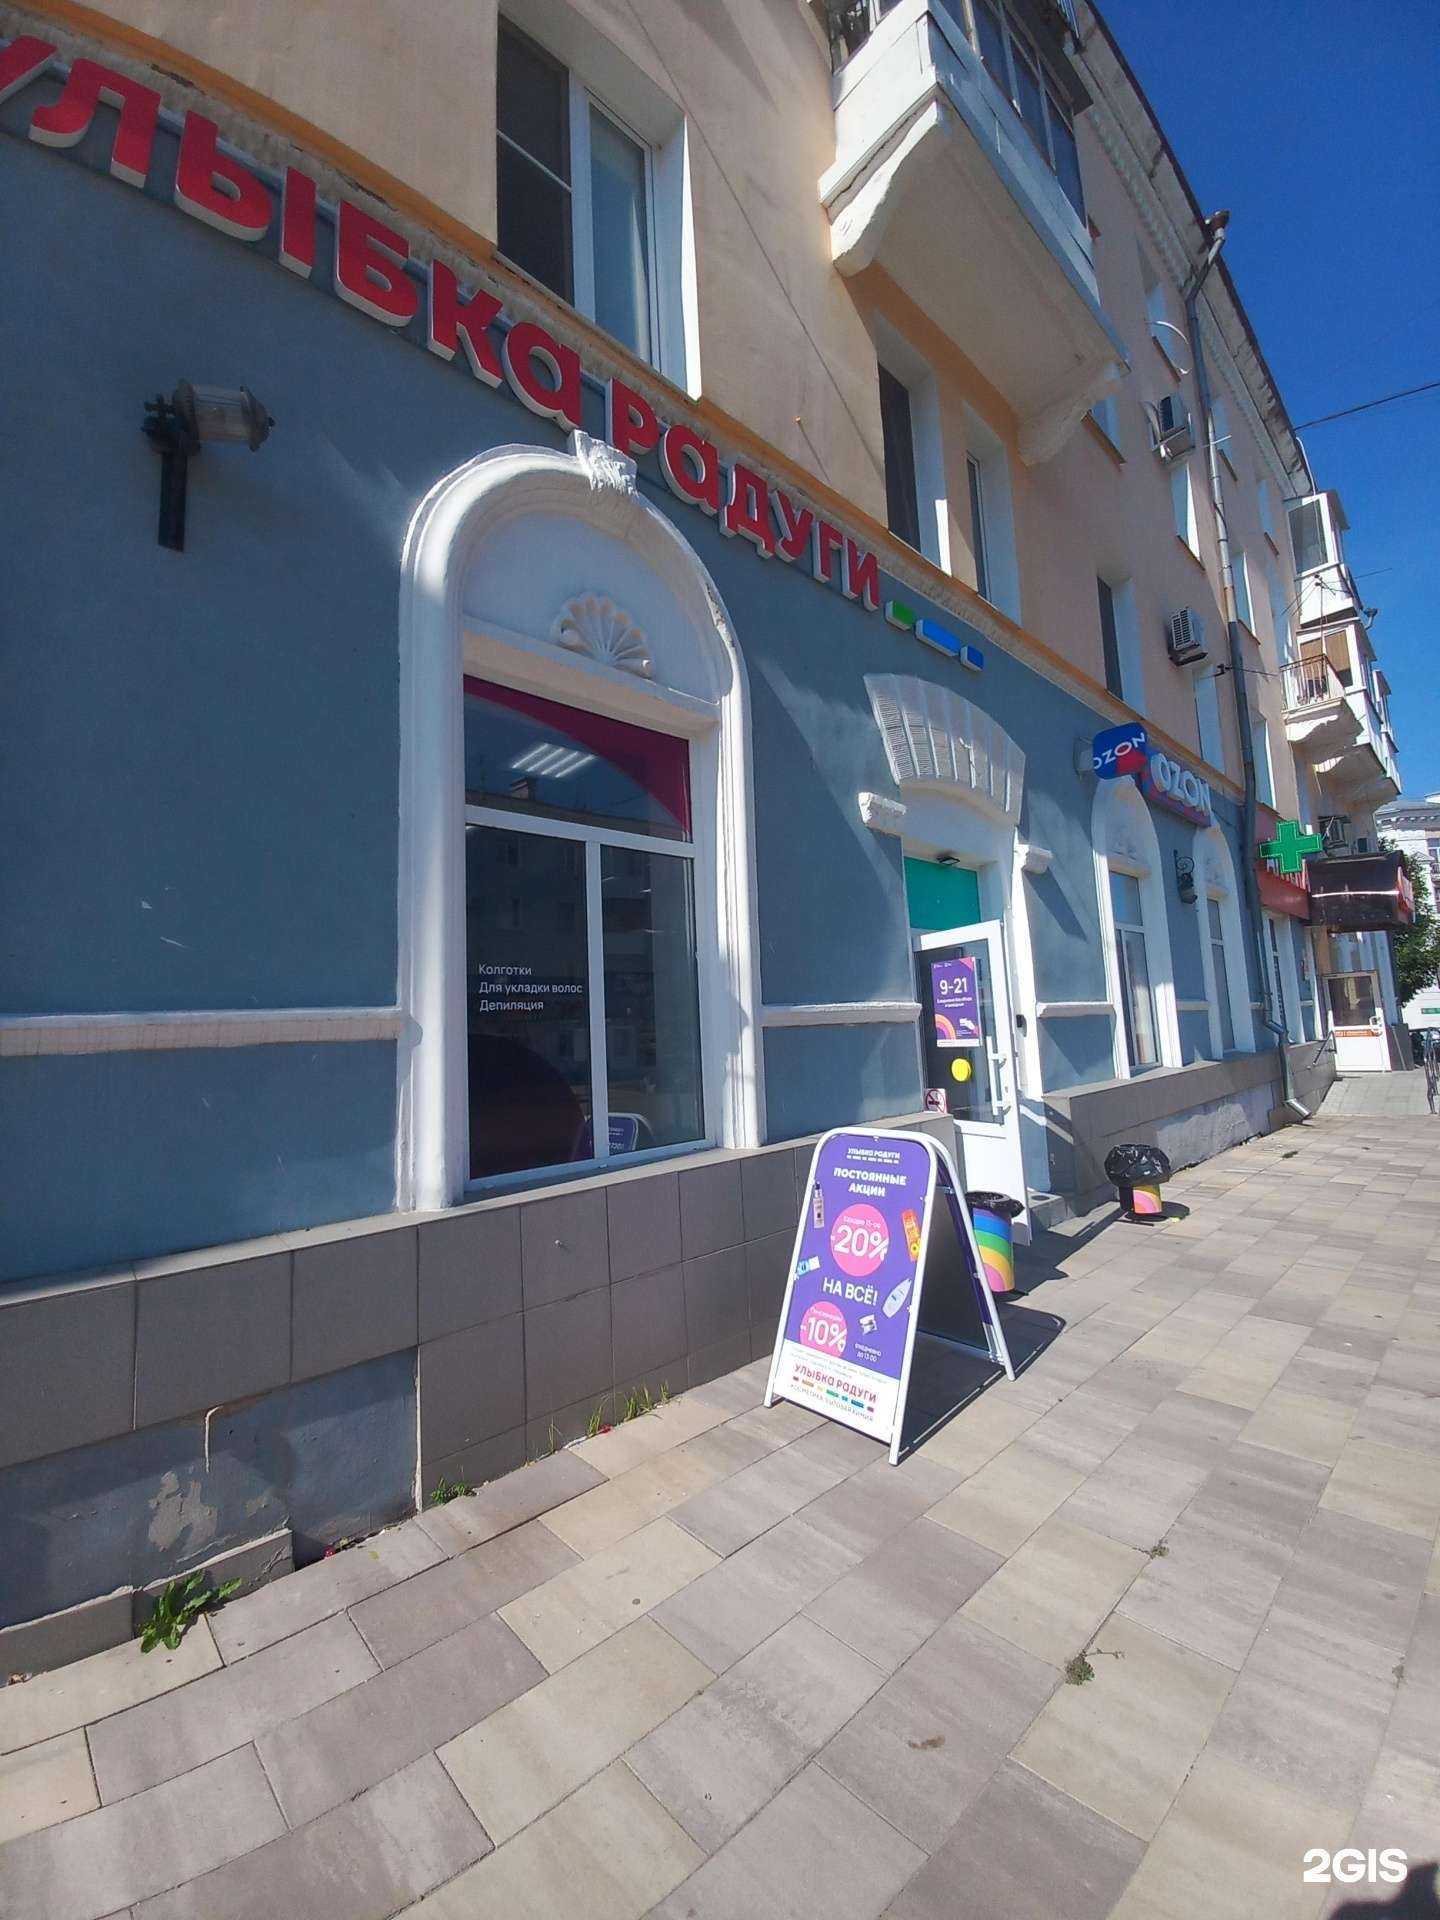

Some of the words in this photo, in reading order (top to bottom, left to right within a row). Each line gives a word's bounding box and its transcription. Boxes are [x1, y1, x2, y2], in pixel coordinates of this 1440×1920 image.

[1093, 732, 1146, 770] OZON
[1150, 752, 1213, 817] OZON
[478, 963, 532, 976] Колготки
[479, 981, 503, 994] Для
[504, 983, 550, 997] укладки
[551, 984, 583, 994] волос
[940, 977, 968, 996] 9-21
[479, 999, 544, 1012] Депиляция
[833, 1167, 907, 1187] ПОСТОЯННЫЕ
[848, 1182, 886, 1198] АКЦИИ
[822, 1277, 843, 1297] НА
[844, 1282, 879, 1307] ВСЁ!
